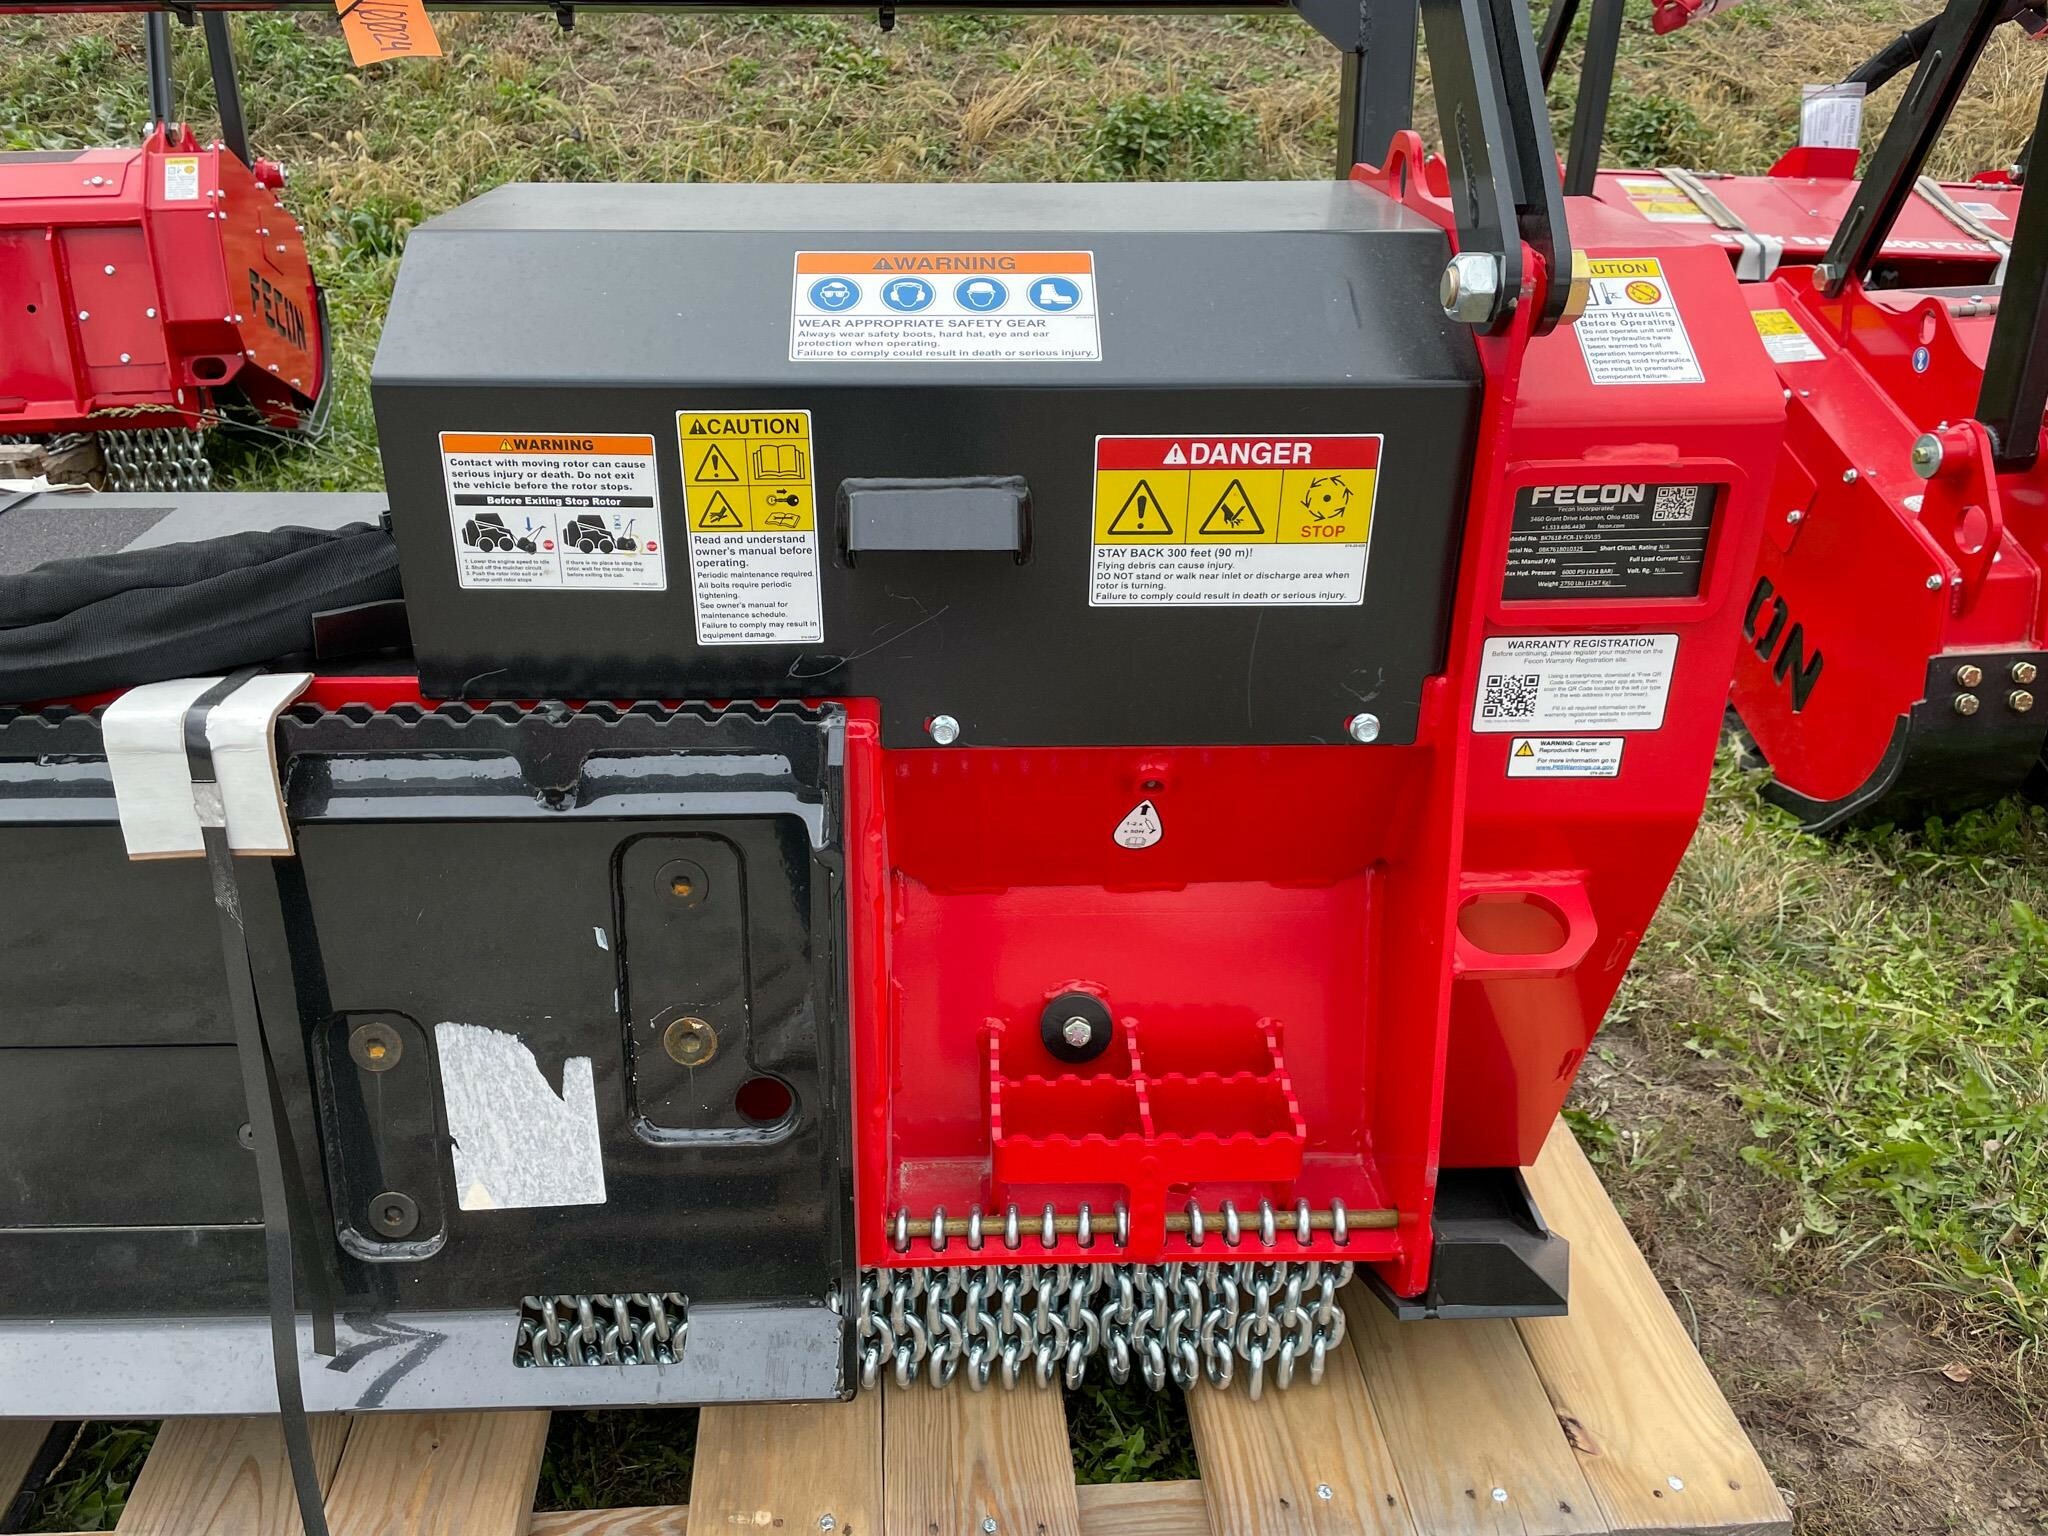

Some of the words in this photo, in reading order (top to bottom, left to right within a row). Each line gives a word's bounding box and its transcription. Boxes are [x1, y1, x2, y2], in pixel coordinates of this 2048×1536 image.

[893, 257, 1016, 270] WARNING
[1590, 264, 1649, 274] UTION
[249, 265, 307, 352] FECON
[1061, 350, 1094, 358] injury.
[707, 418, 799, 434] CAUTION
[514, 439, 594, 450] WARNING
[1190, 442, 1313, 465] DANGER
[493, 470, 524, 479] injury
[600, 483, 633, 491] stops.
[1532, 484, 1646, 506] FECON
[486, 496, 522, 504] Before
[525, 496, 562, 506] Exiting
[565, 497, 589, 507] Stop
[592, 497, 621, 508] Rotor
[1301, 525, 1346, 538] STOP
[694, 535, 721, 544] Read
[746, 535, 805, 543] understand
[779, 546, 812, 554] before
[1098, 548, 1127, 557] STAY
[1130, 548, 1164, 557] BACK
[1167, 548, 1187, 557] 300
[1190, 548, 1211, 557] feet
[1214, 548, 1232, 559] (90
[1234, 548, 1254, 559] m)!
[696, 559, 750, 569] operating.
[1097, 561, 1125, 571] Flying
[1207, 562, 1235, 570] injury.
[1256, 572, 1300, 580] discharge
[1131, 582, 1167, 590] turning.
[1140, 593, 1174, 601] comply
[1319, 592, 1347, 600] injury.
[1508, 640, 1571, 649] WARRANTY
[1573, 638, 1654, 648] REGISTRATION
